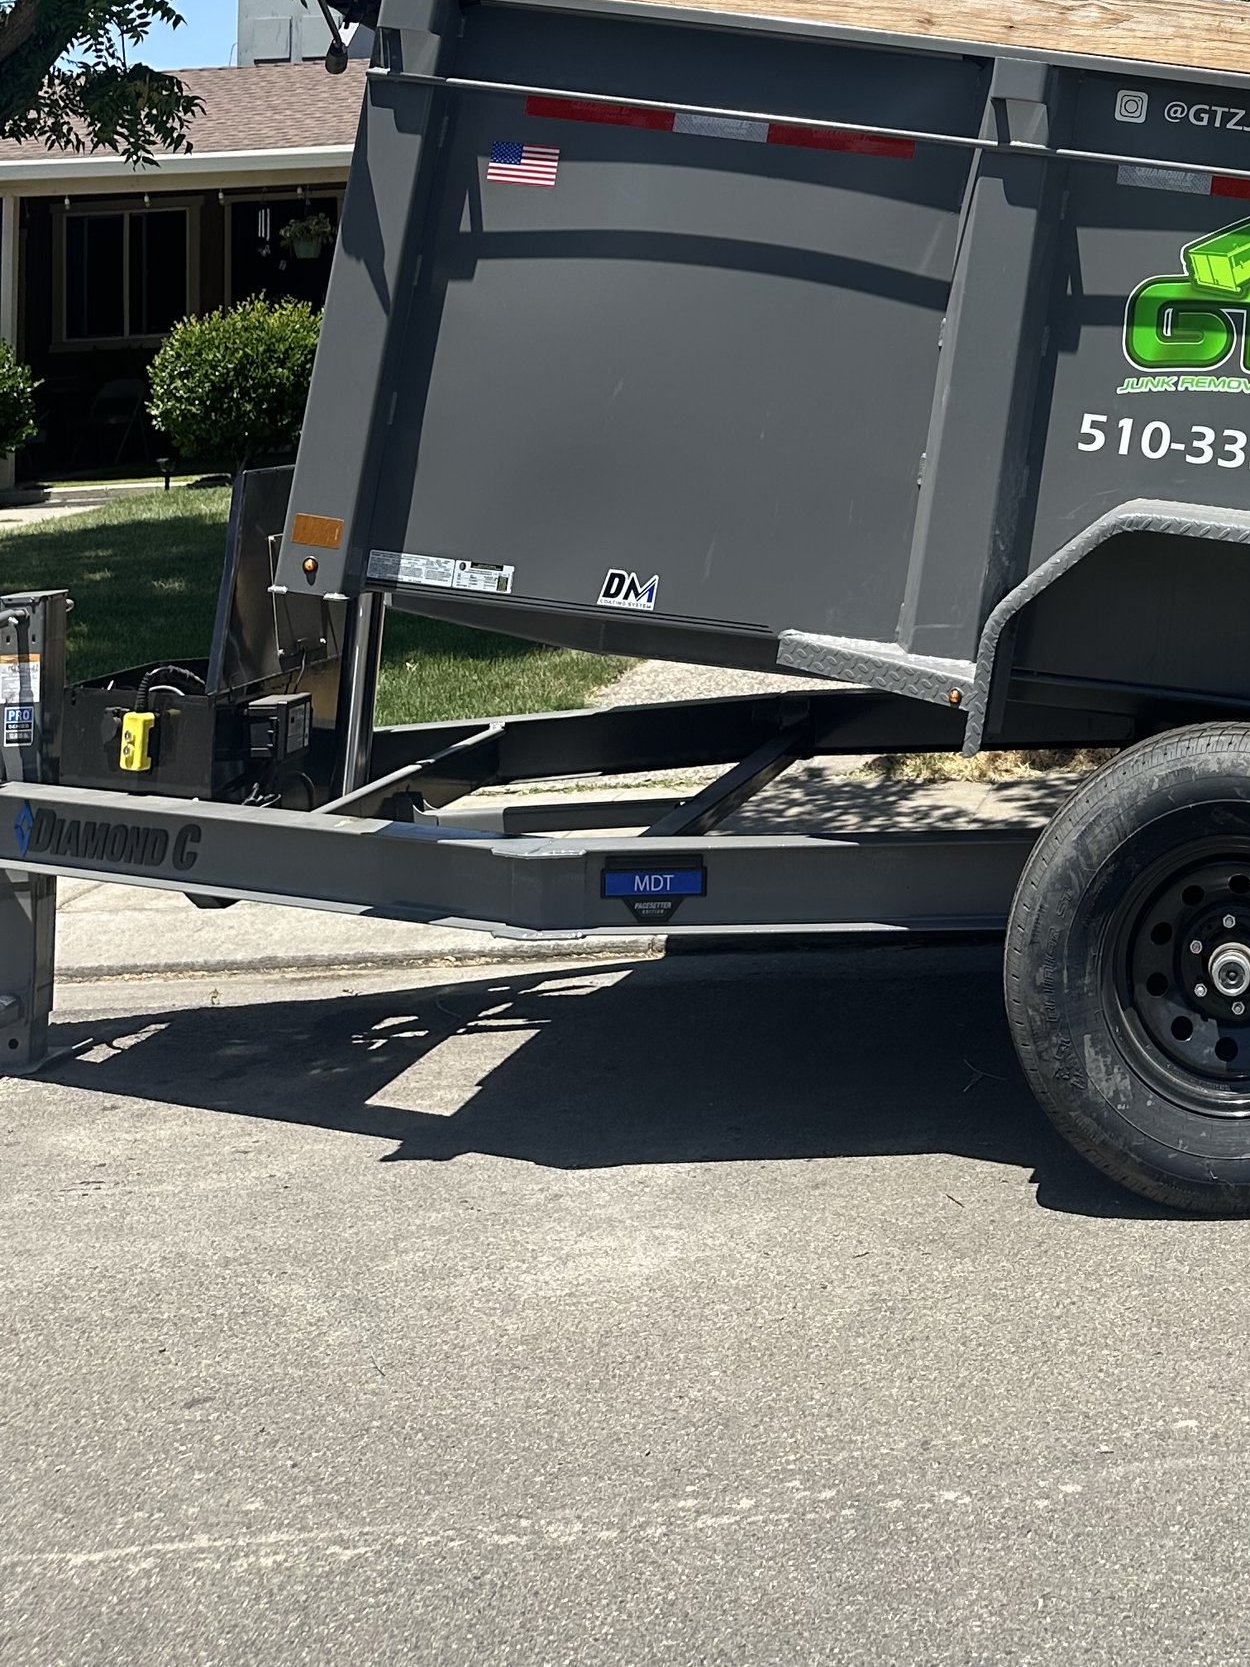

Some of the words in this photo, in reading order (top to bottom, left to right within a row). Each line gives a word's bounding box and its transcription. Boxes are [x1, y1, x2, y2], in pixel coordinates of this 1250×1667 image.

[1117, 377, 1178, 395] JUNK
[602, 572, 657, 603] DM
[8, 710, 30, 722] PRO
[28, 807, 169, 867] DIAMOND
[172, 823, 202, 871] C
[634, 874, 675, 892] MDT
